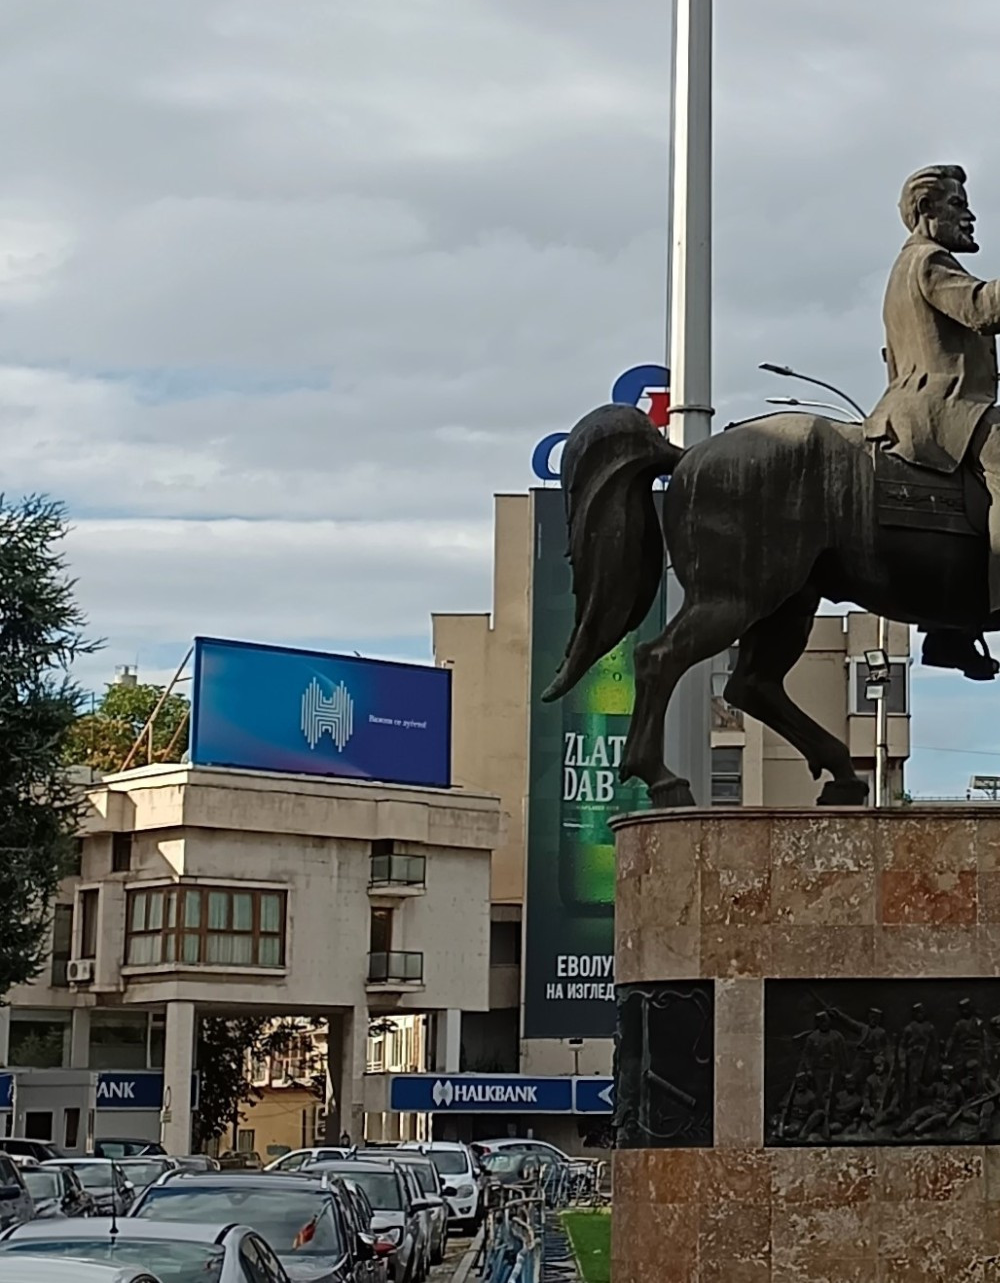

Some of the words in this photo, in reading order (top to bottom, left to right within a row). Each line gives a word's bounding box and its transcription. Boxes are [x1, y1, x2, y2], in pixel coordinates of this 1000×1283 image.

[564, 732, 627, 767] ZLAT
[563, 767, 614, 802] DAB
[557, 955, 613, 977] ЕВОЛУ
[546, 983, 563, 999] НА
[96, 1081, 135, 1098] ANK
[455, 1085, 538, 1102] HALKBANK
